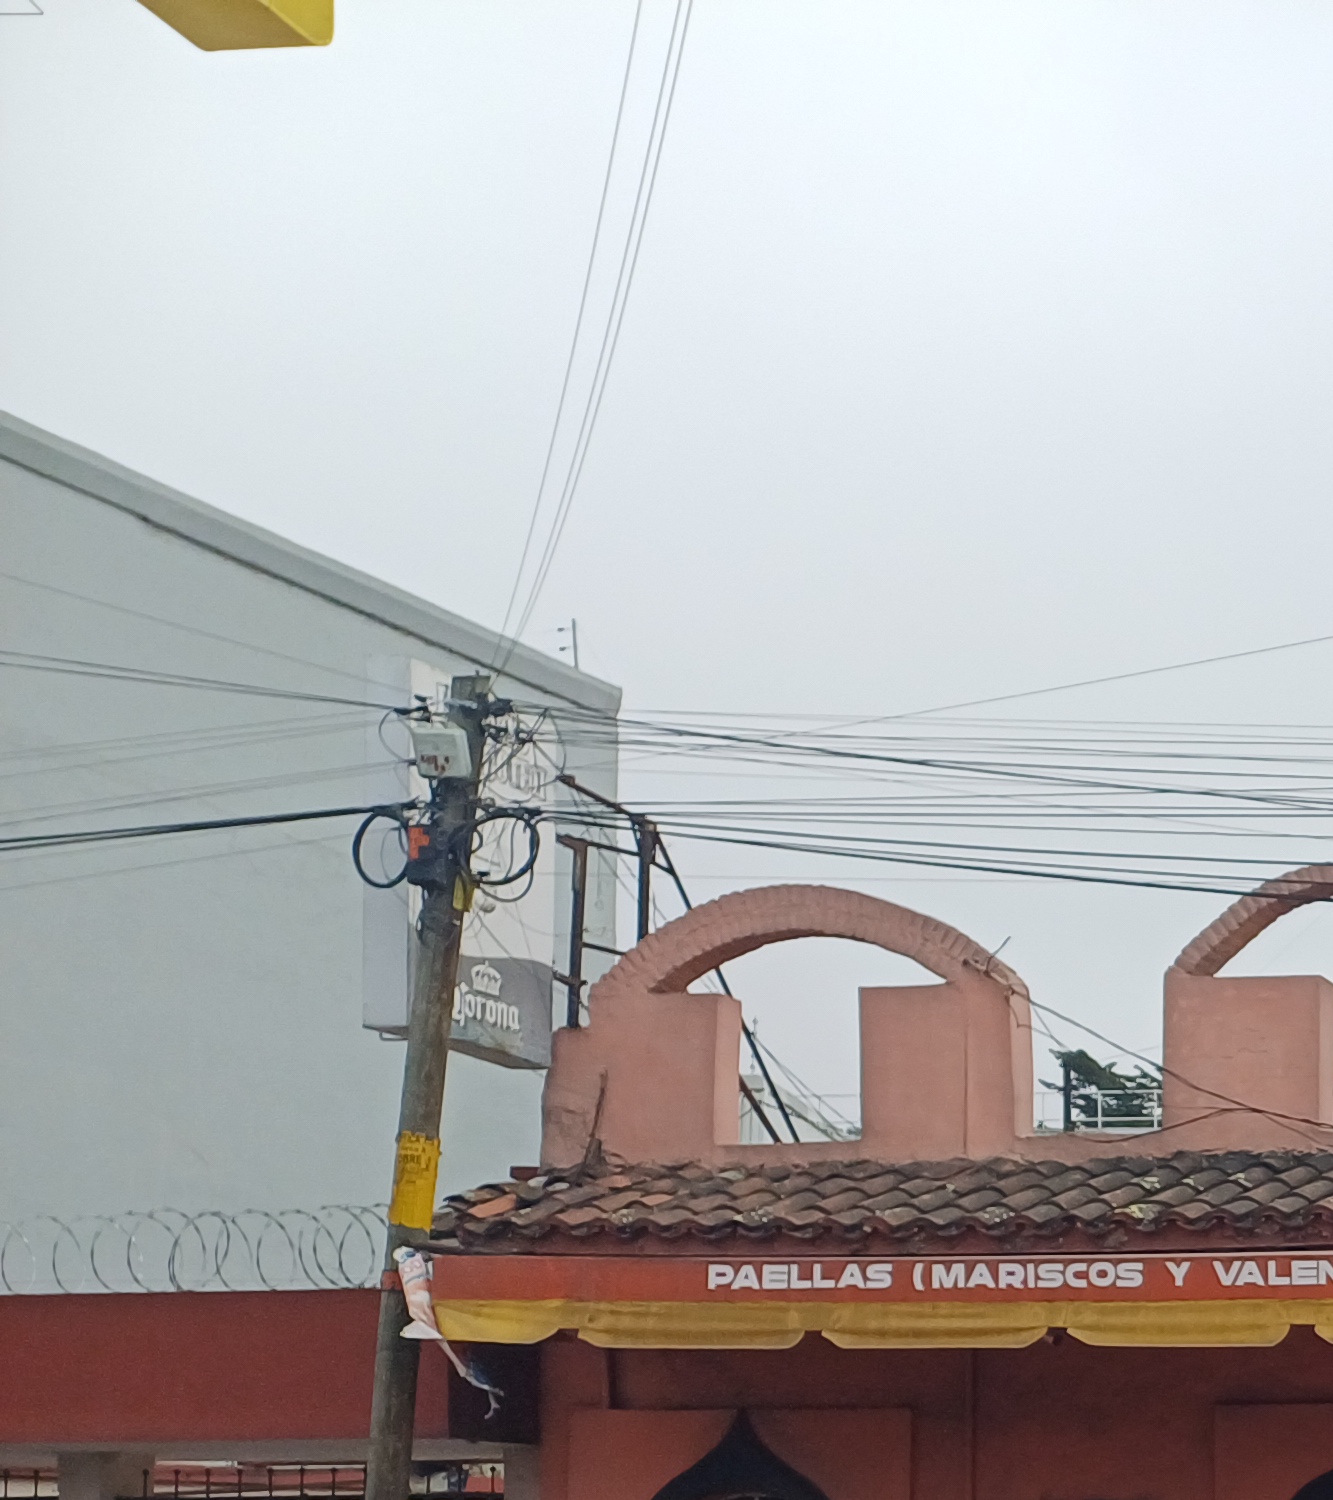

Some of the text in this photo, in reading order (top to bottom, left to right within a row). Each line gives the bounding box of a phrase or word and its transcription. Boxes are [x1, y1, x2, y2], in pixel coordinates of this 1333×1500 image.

[452, 981, 519, 1031] Corona
[707, 1261, 894, 1290] PAELLAS
[912, 1260, 1144, 1292] (MARISCOS
[1165, 1261, 1192, 1288] Y
